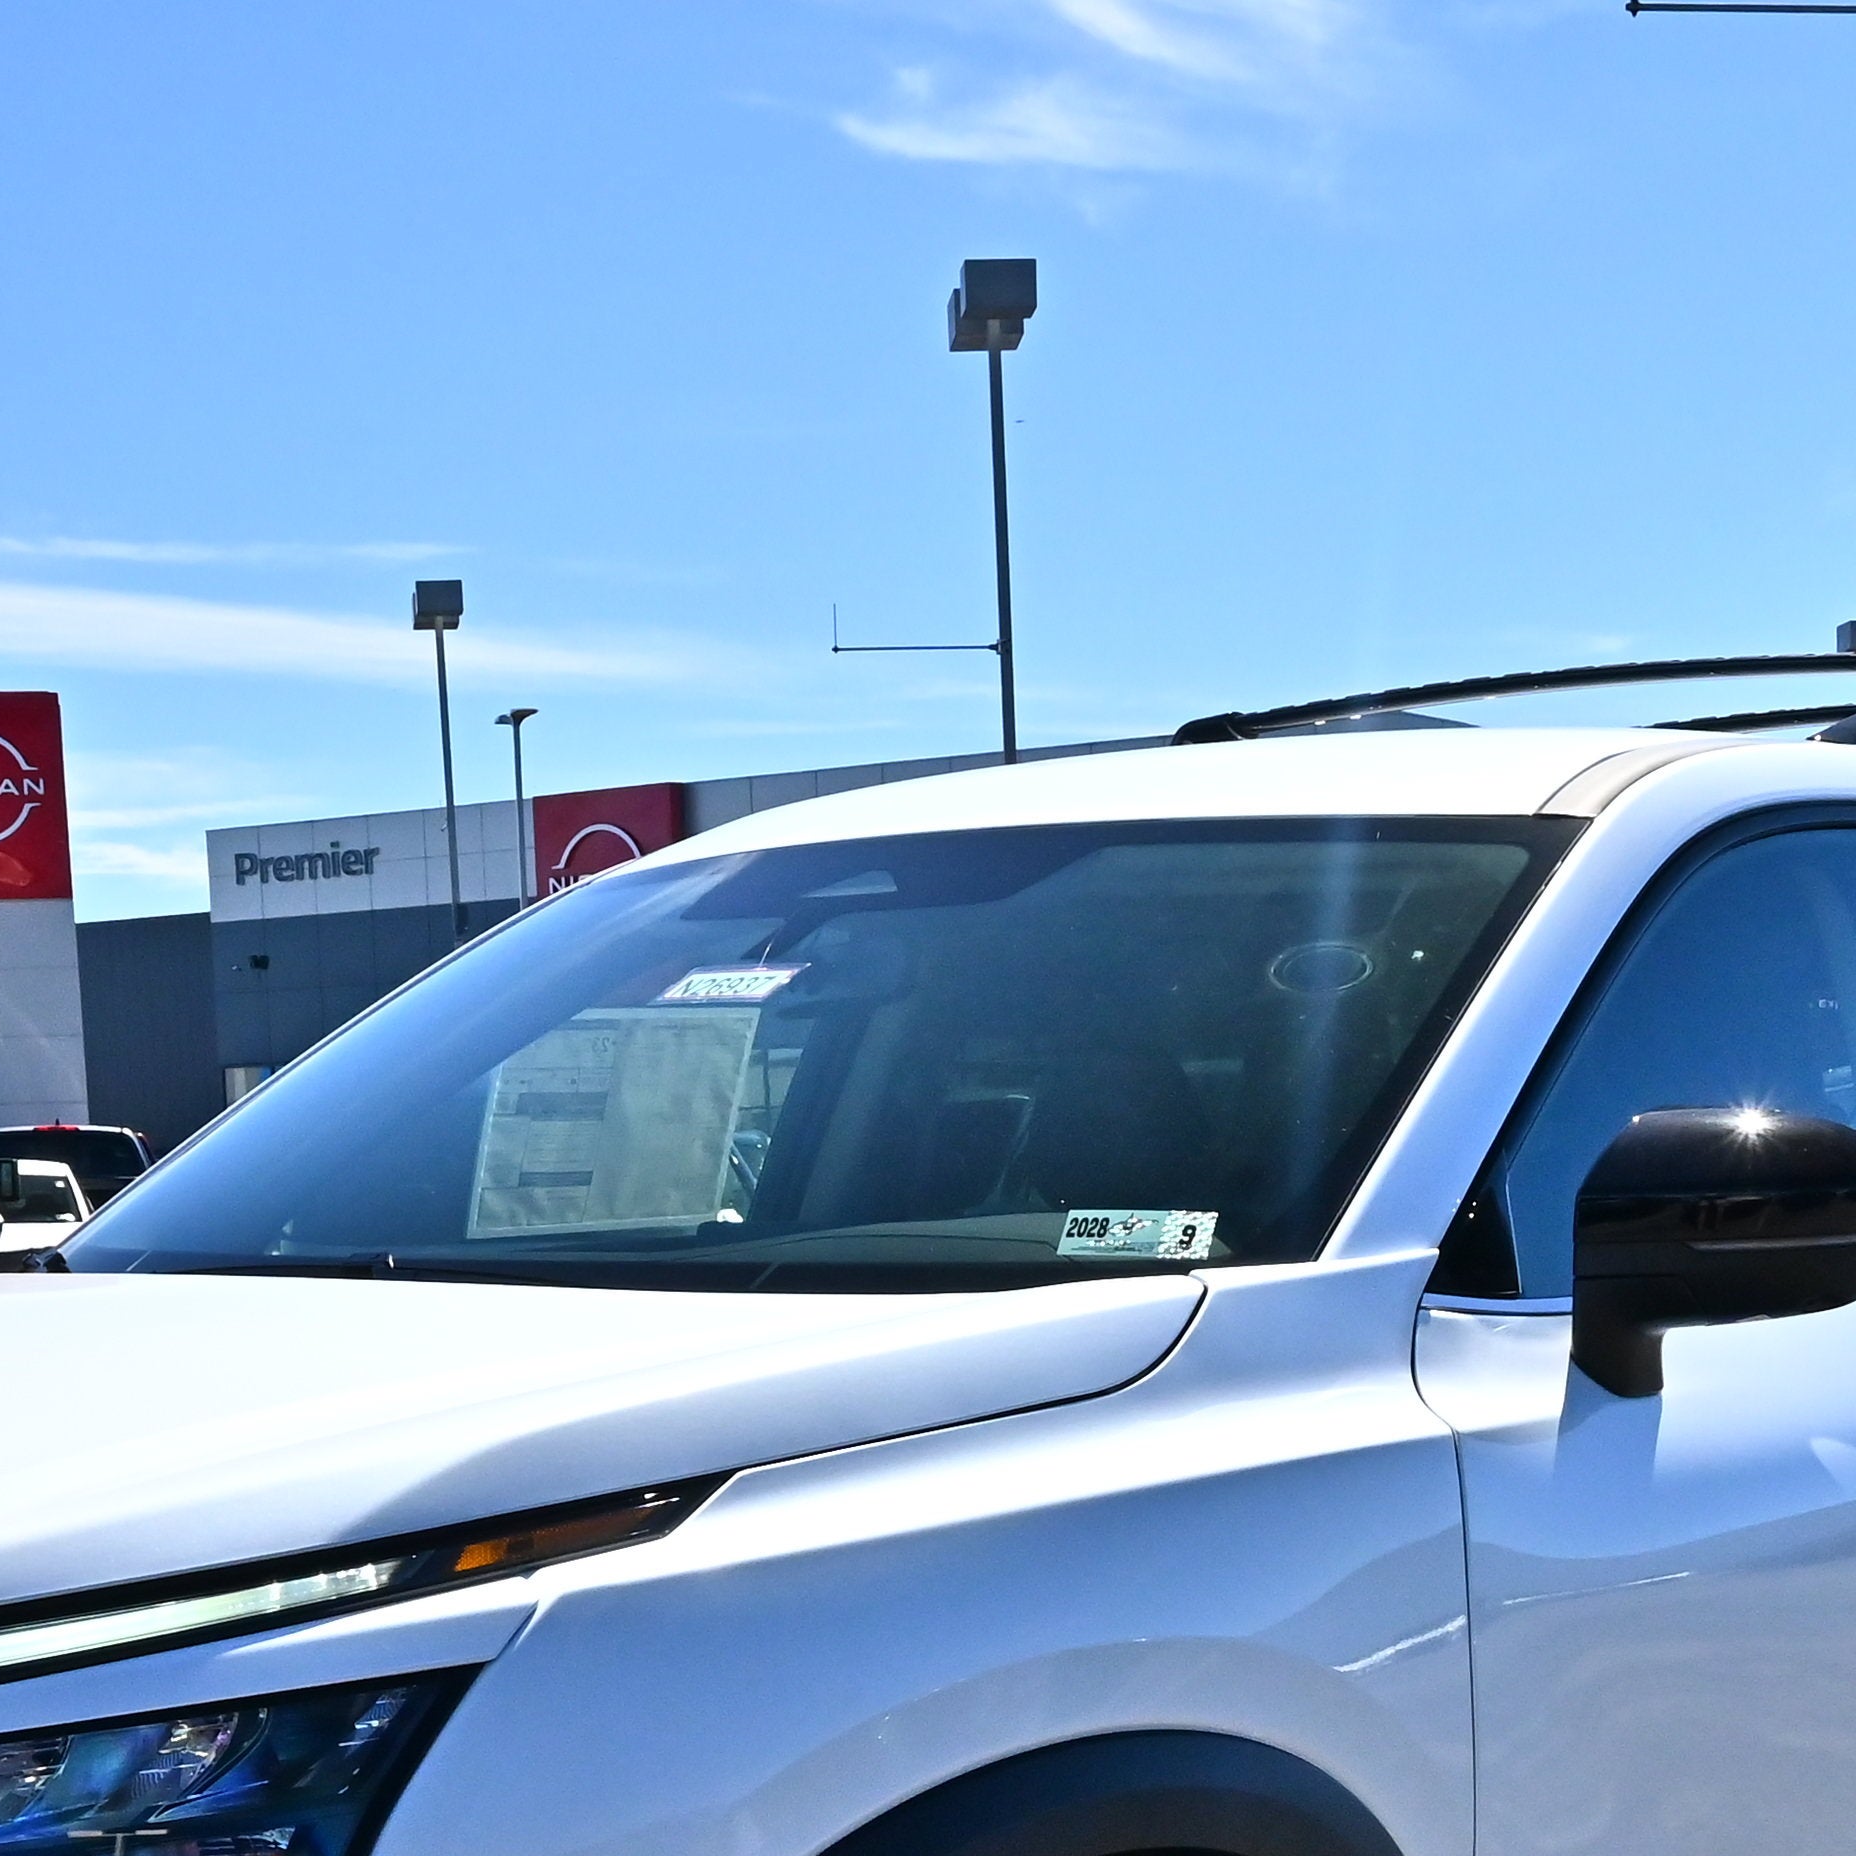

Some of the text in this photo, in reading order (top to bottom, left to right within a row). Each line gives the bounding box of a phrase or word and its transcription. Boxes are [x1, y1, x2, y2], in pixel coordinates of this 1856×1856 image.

[234, 840, 380, 886] Premier
[676, 976, 778, 997] N26937
[1066, 1217, 1110, 1239] 2028
[1178, 1224, 1198, 1251] 9
